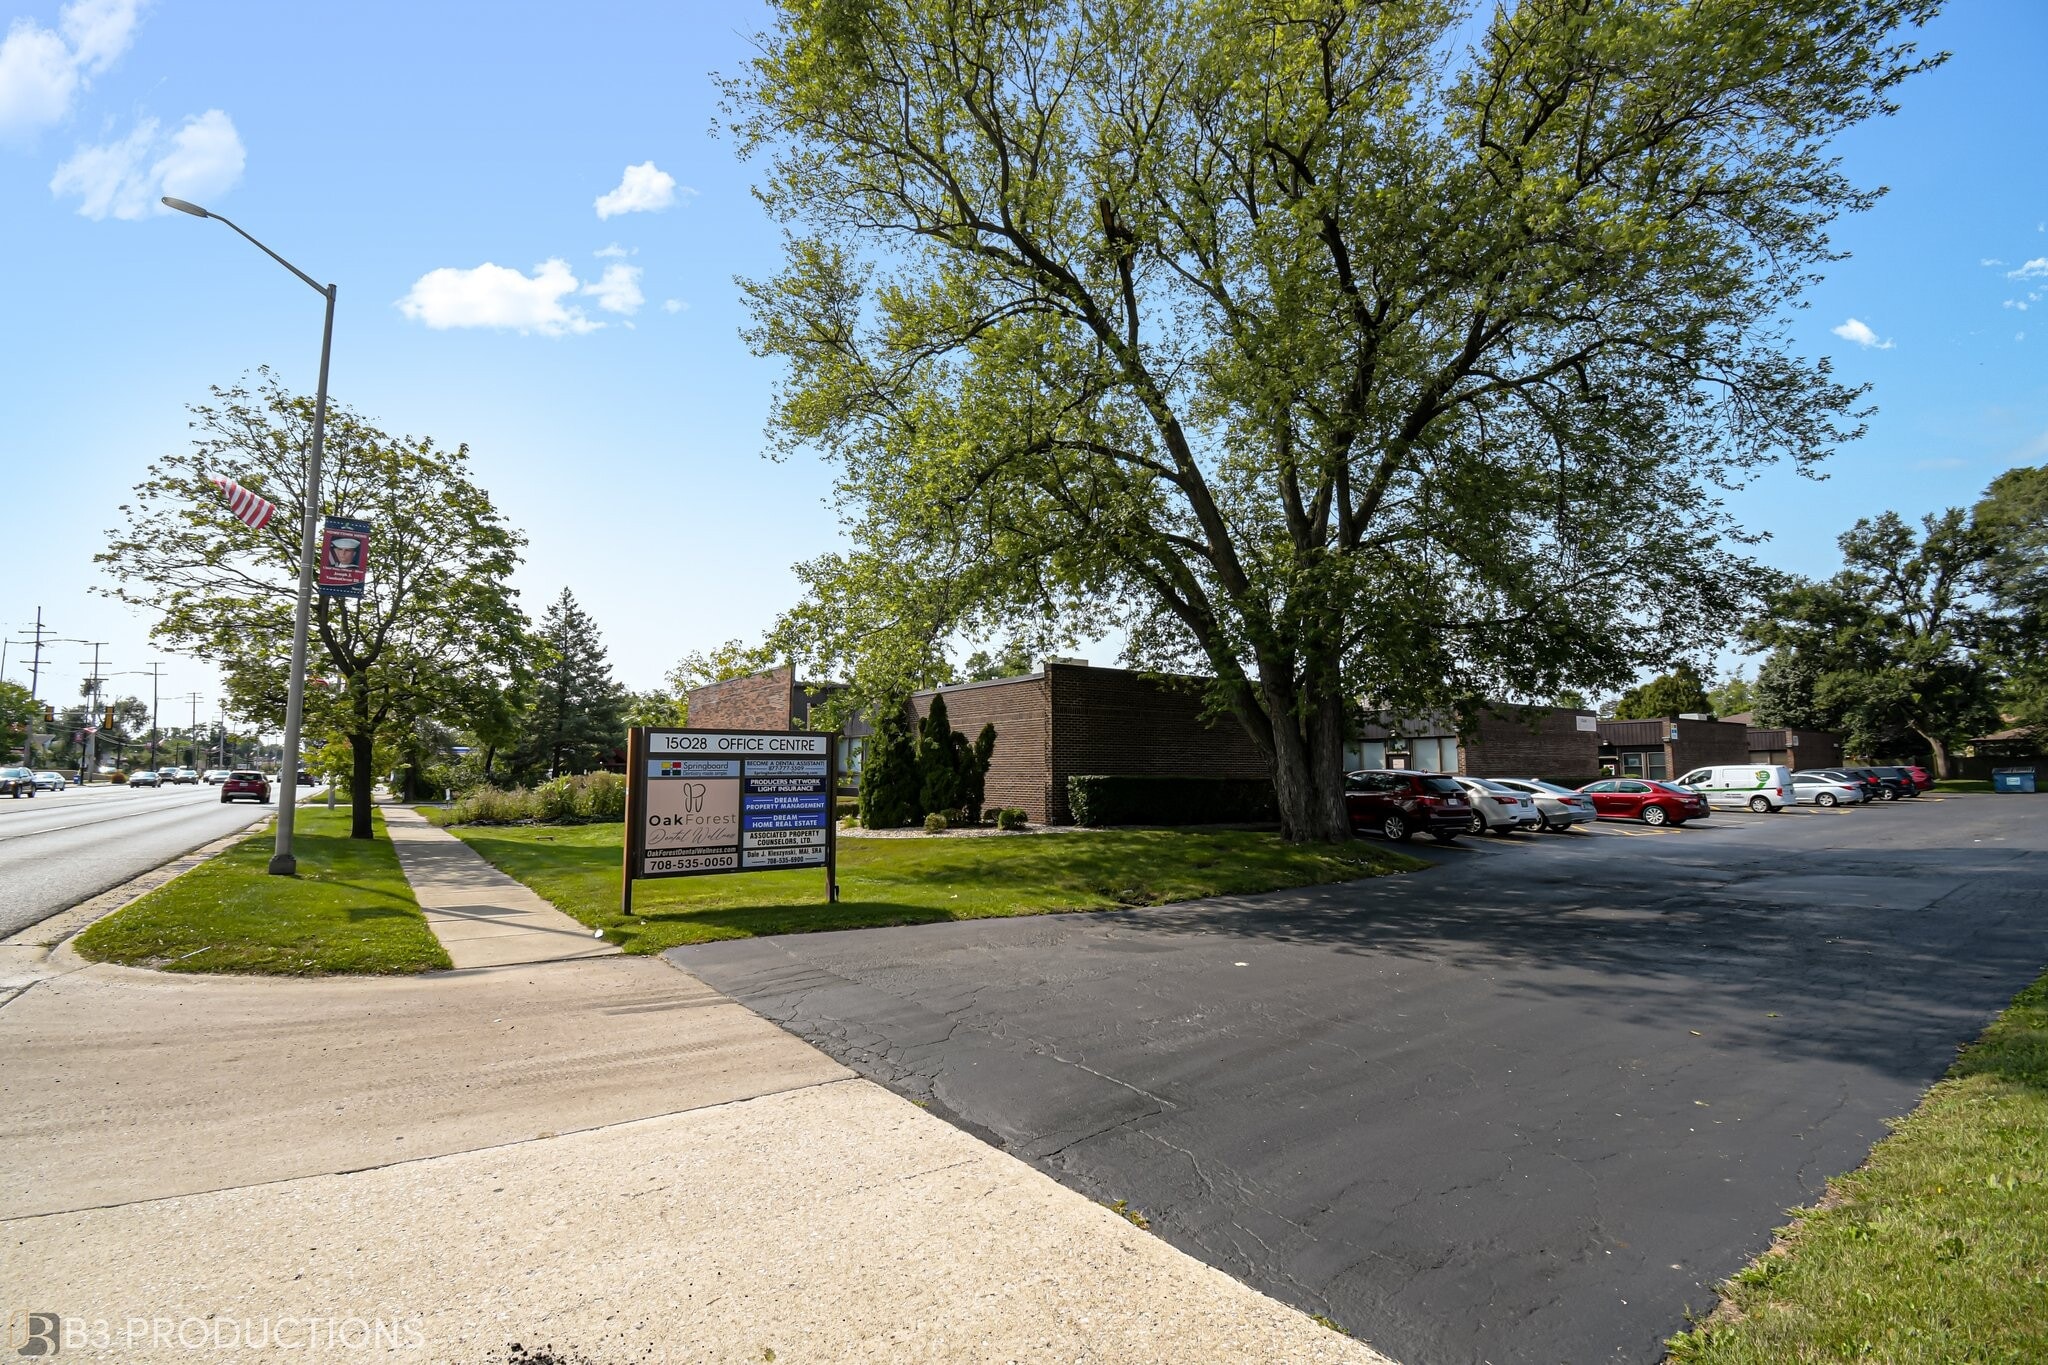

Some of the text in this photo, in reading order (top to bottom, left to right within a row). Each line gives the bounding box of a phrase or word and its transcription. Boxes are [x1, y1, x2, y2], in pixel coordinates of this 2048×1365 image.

[666, 737, 815, 751] 15028 OFFICE CENTRE
[683, 762, 728, 770] Springboard
[648, 826, 736, 845] Dental Wellness
[647, 847, 736, 857] OakForestDentalWellness.com
[650, 857, 732, 871] 708-535-0050
